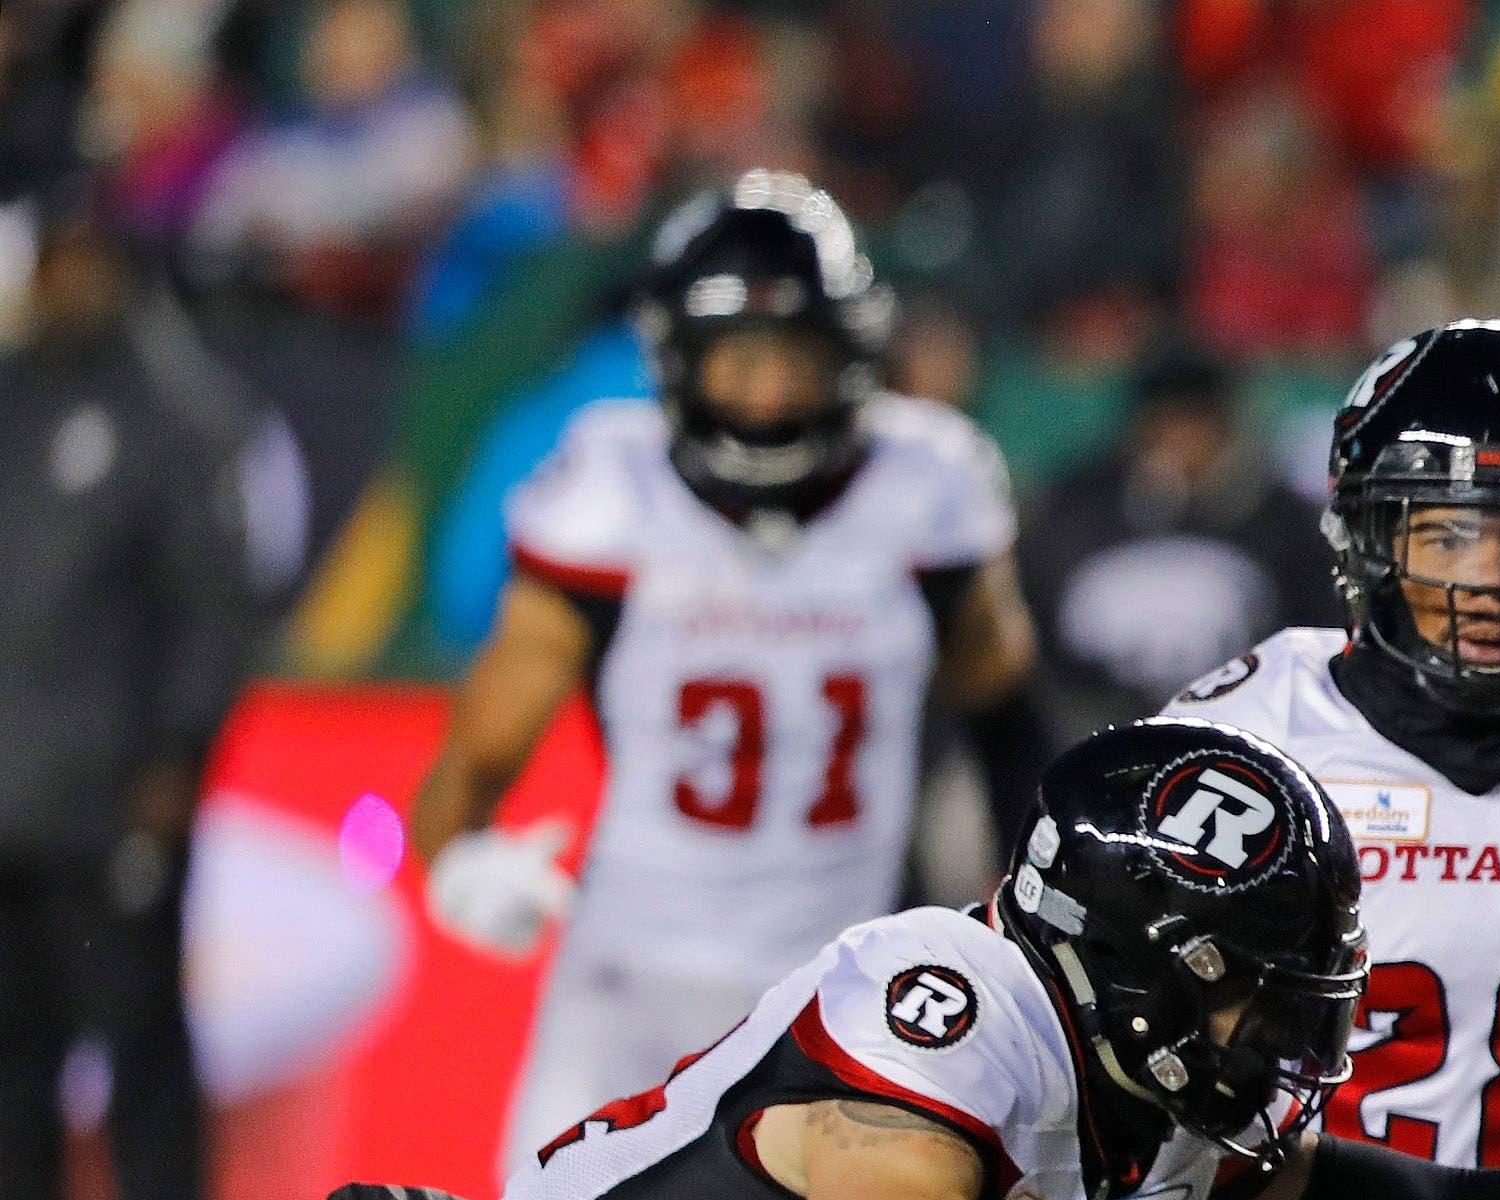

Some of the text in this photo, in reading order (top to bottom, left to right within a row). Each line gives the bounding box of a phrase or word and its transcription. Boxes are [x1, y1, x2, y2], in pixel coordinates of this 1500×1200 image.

[676, 664, 868, 834] 31
[1156, 767, 1276, 870] R
[890, 971, 968, 1039] R
